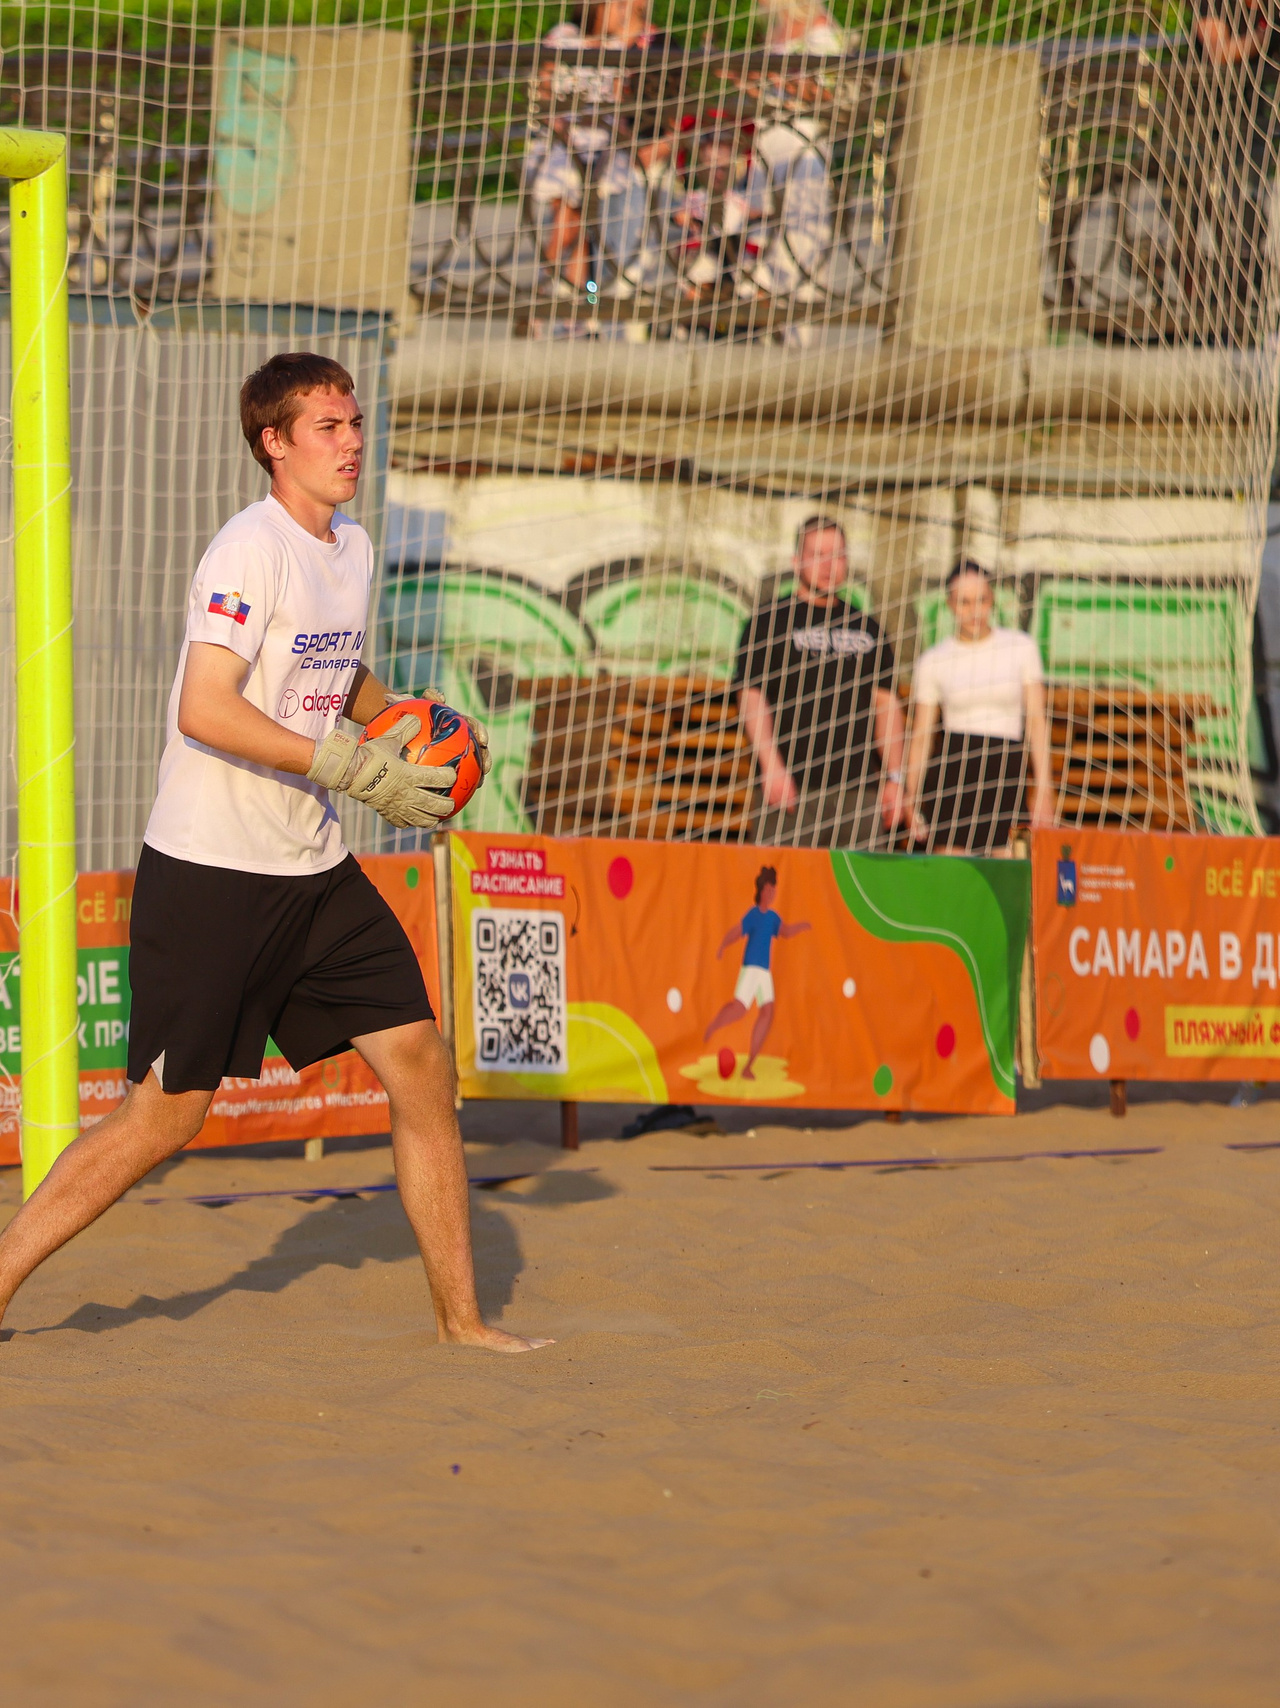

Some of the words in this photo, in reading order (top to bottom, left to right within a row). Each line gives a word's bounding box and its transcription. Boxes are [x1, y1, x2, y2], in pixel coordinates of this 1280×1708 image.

[291, 631, 352, 654] SPORT
[300, 657, 360, 671] Самара
[489, 849, 543, 871] УЗНАТЬ
[472, 872, 564, 897] РАСПИСАНИЕ
[1206, 858, 1243, 897] ВСЁ
[79, 891, 106, 924] СЁ
[1069, 926, 1209, 980] САМАРА
[1219, 931, 1243, 981] В
[1173, 1013, 1265, 1047] ПЛЯЖНЫЙ
